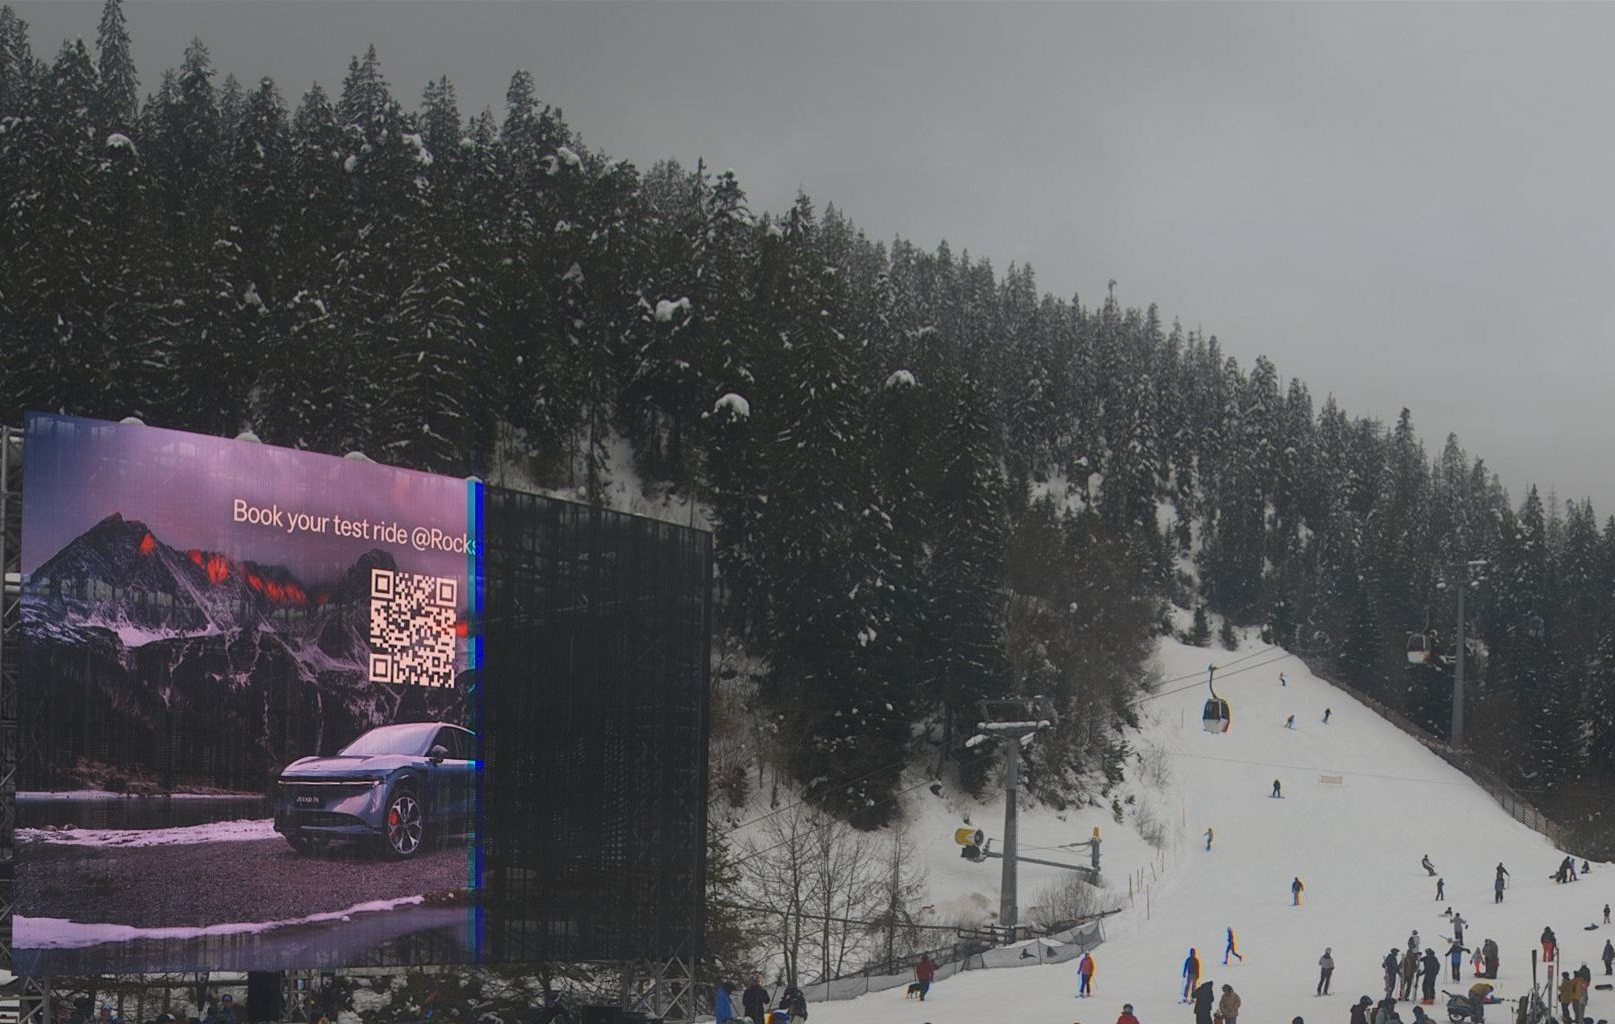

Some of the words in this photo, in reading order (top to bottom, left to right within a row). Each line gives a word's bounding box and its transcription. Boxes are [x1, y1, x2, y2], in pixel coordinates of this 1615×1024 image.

[233, 498, 283, 528] Book
[287, 510, 330, 533] your
[333, 516, 370, 540] test
[373, 521, 408, 544] ride
